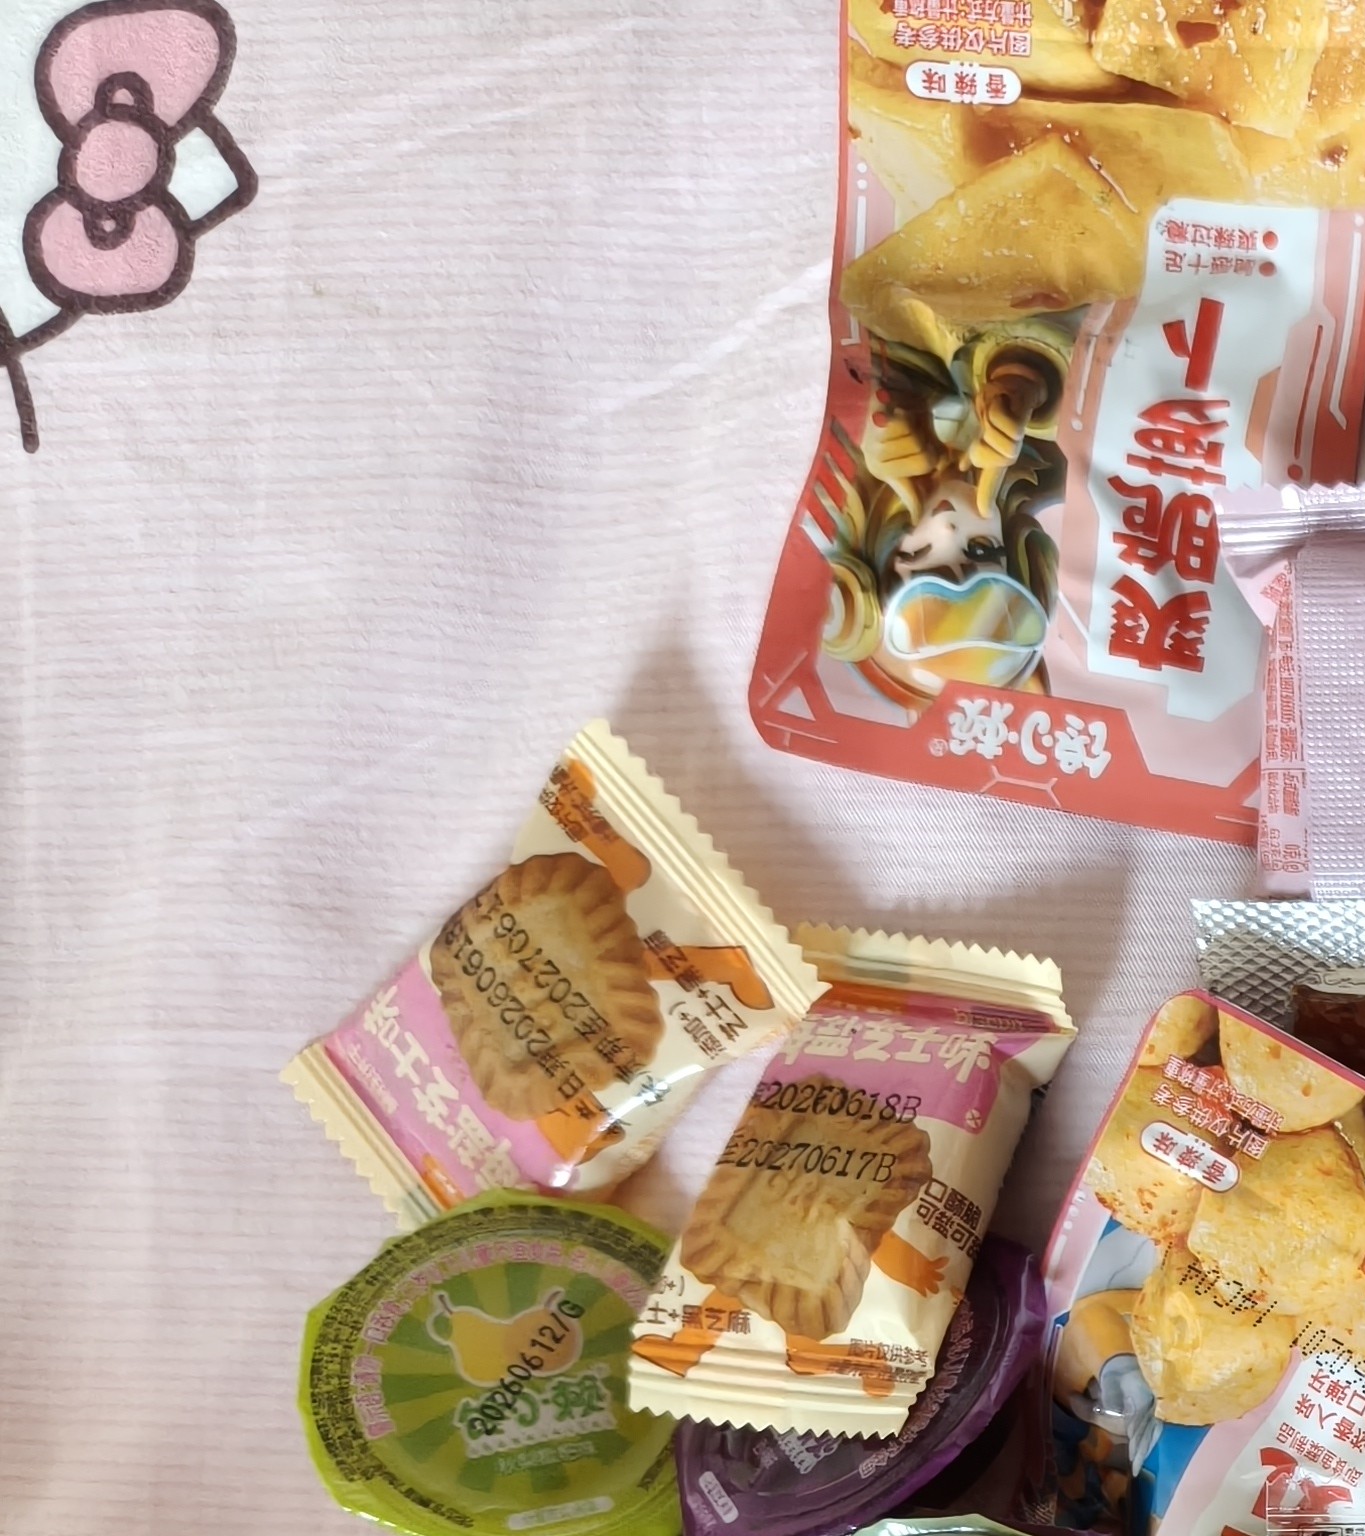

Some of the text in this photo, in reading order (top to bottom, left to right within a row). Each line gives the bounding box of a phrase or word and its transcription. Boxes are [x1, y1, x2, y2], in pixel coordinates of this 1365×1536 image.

[893, 24, 1032, 54] 图片仅供参考
[919, 69, 1007, 97] 香辣味
[1108, 297, 1228, 672] 爽脆萝卜
[948, 691, 1105, 779] 馋小赖
[1148, 1128, 1230, 1186] 香辣味
[1149, 1080, 1270, 1160] 图片仅供参考
[467, 1299, 585, 1438] 20260612/G
